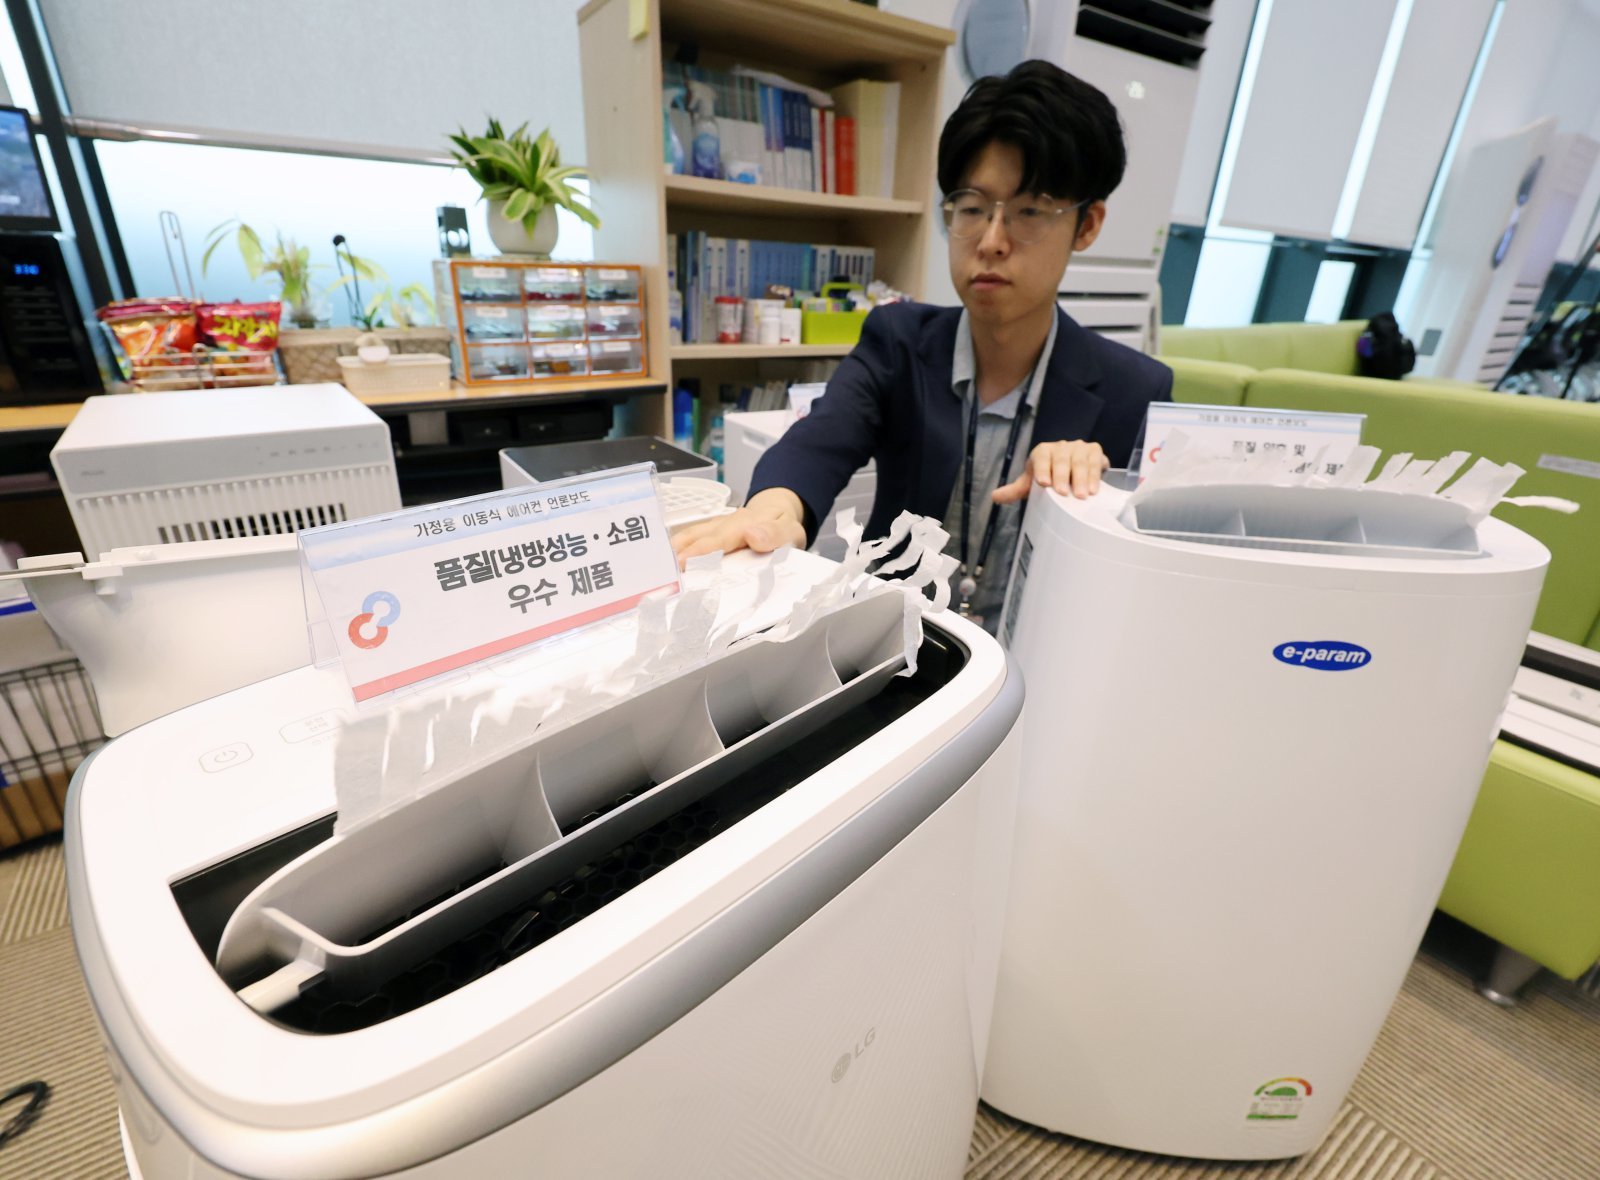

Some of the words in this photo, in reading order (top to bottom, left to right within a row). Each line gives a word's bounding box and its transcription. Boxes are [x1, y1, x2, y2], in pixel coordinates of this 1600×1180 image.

[413, 517, 456, 538] 가정용
[462, 509, 502, 528] 이동식
[507, 500, 542, 519] 에어컨
[547, 490, 591, 511] 언론보도
[508, 577, 559, 614] 우수
[567, 560, 614, 597] 제품
[1282, 646, 1366, 664] e-param
[854, 1026, 876, 1059] LG
